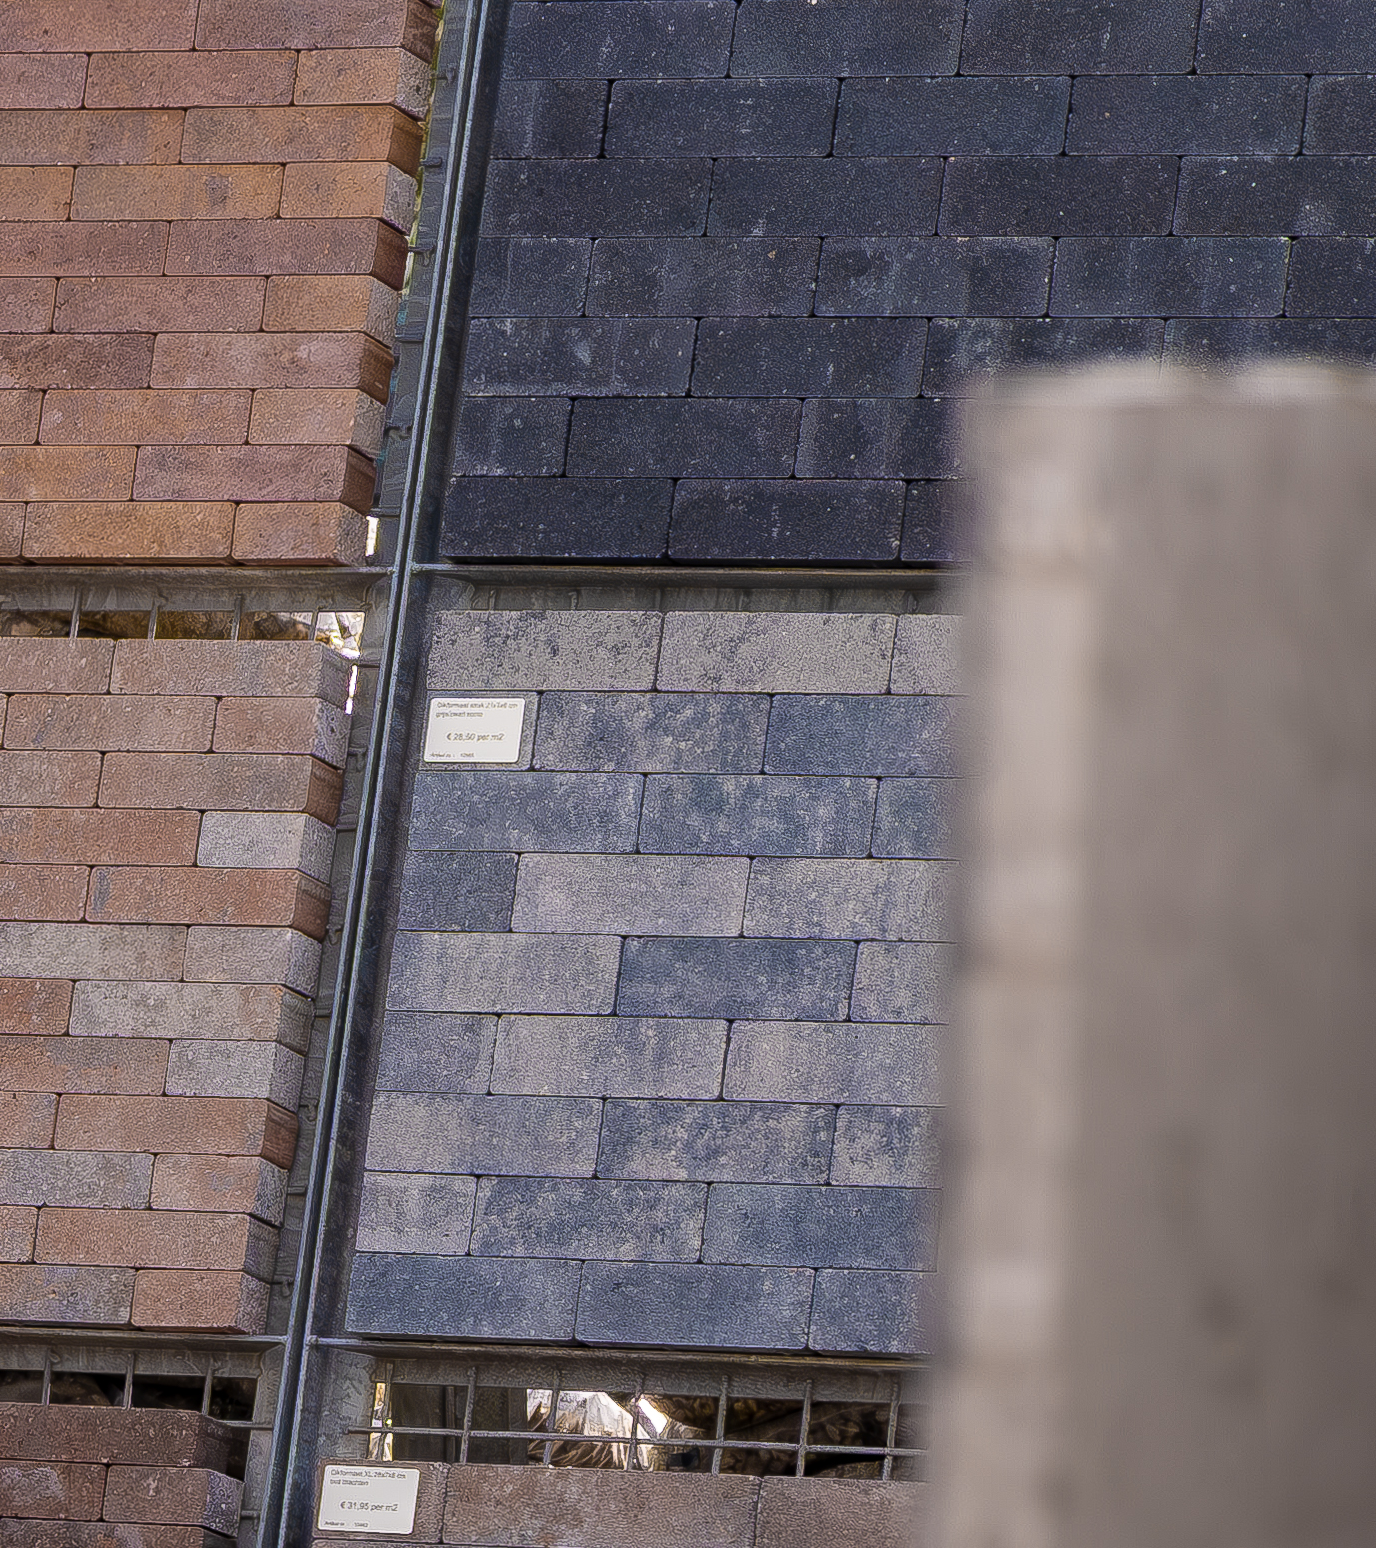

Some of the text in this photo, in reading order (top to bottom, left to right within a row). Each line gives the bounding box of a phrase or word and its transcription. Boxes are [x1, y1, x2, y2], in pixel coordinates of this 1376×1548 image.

[453, 732, 476, 741] 28,50
[477, 734, 490, 742] per
[490, 733, 505, 741] m2
[347, 1501, 369, 1511] 31,95
[370, 1504, 384, 1512] per
[385, 1503, 399, 1512] m2
